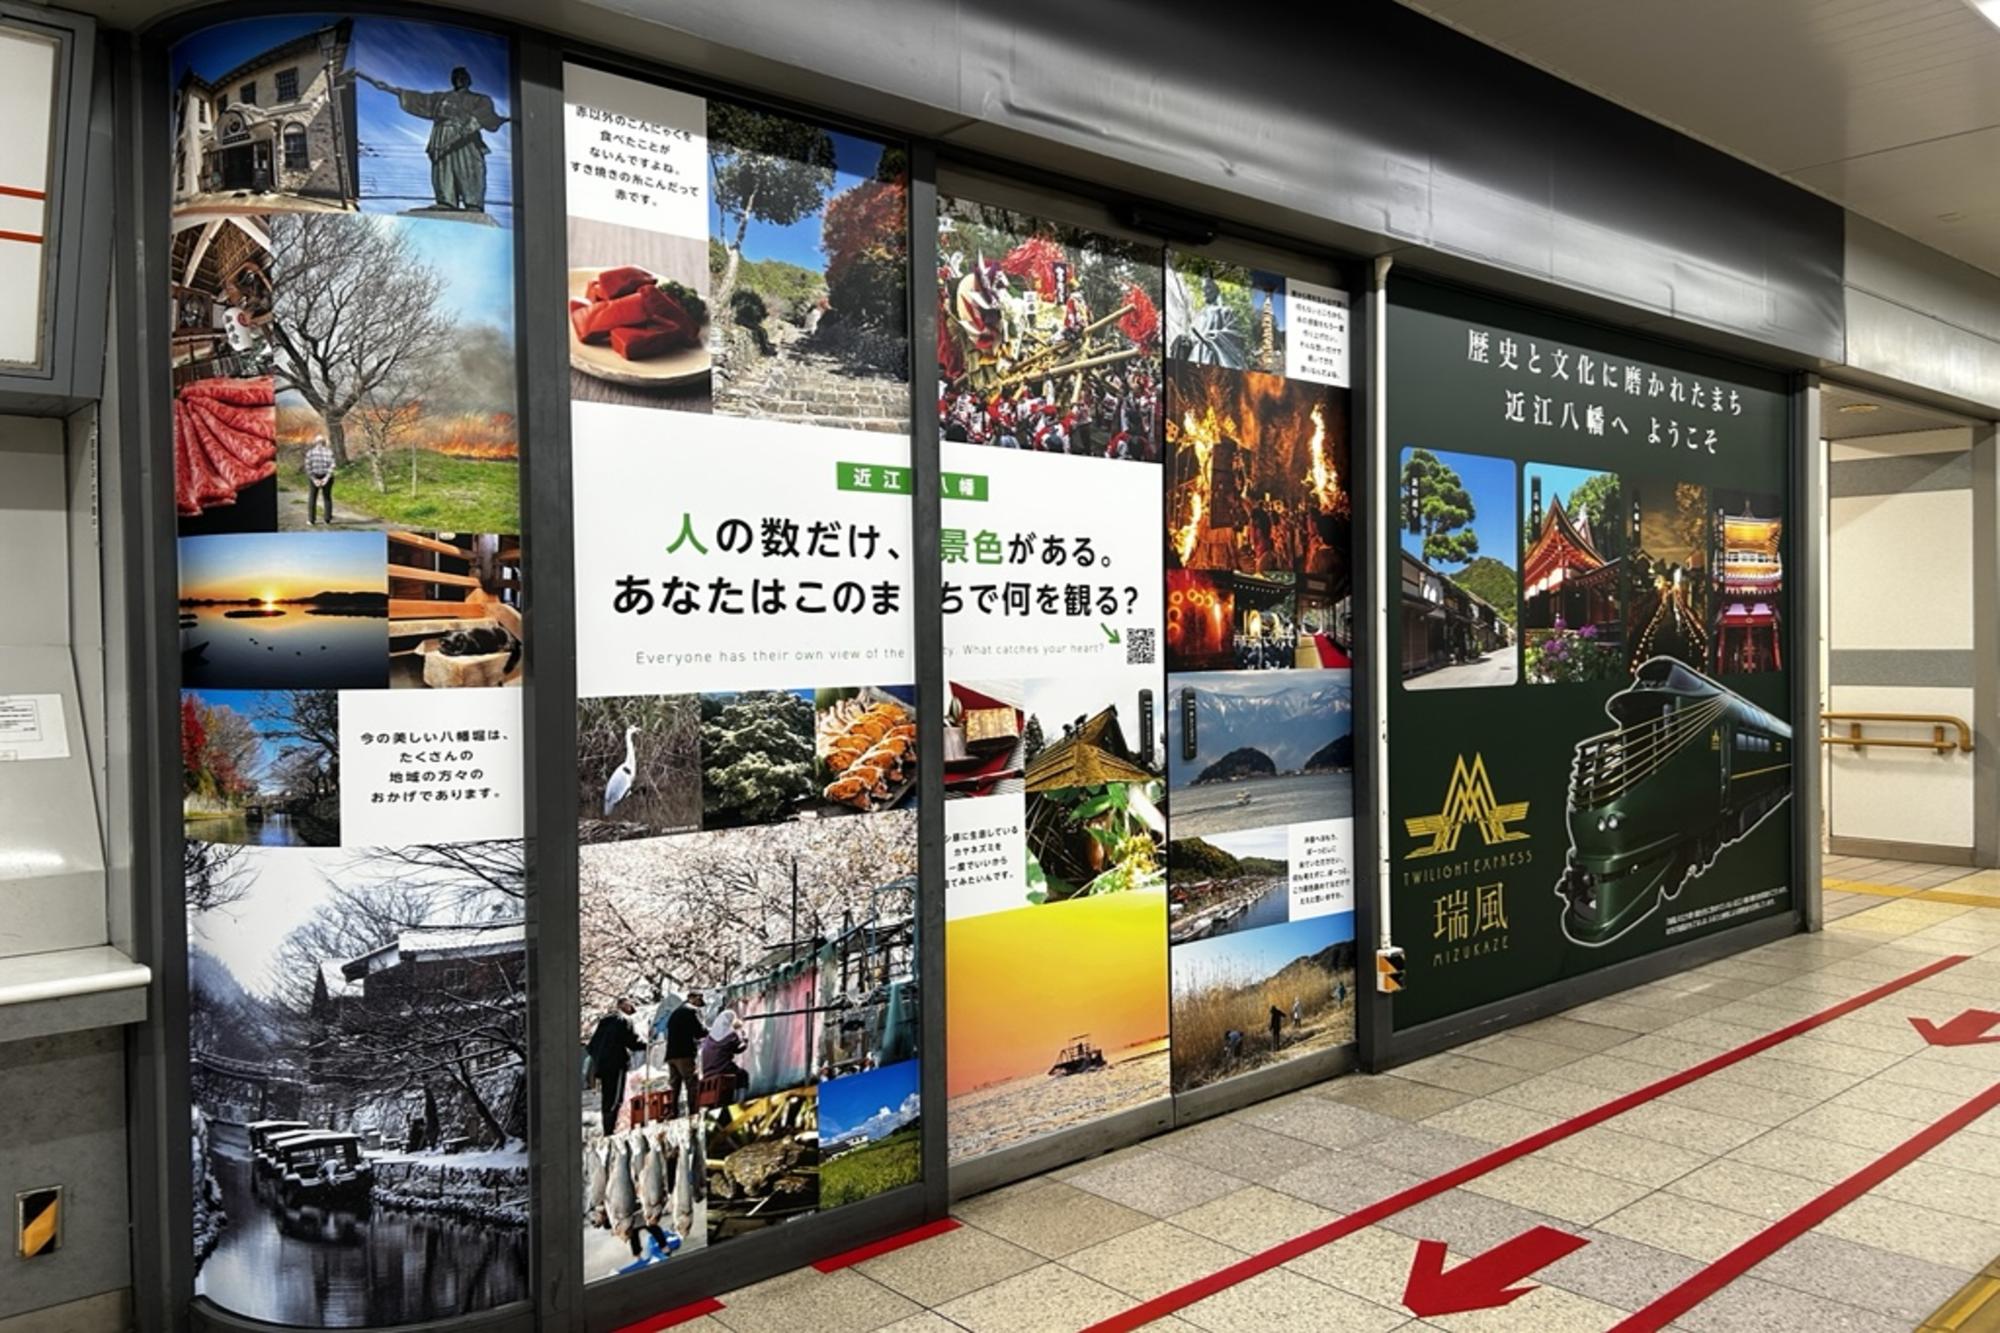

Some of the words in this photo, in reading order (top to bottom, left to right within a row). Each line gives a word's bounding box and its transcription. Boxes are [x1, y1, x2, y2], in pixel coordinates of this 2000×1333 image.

[576, 105, 693, 142] 赤以外のこんにゃくを
[600, 130, 671, 154] 食べたことが
[589, 146, 680, 175] ないんですよね。
[570, 161, 699, 197] すき焼きの糸こんだって
[615, 189, 657, 206] 赤です。
[1467, 329, 1742, 416] 歴史と文化に磨かれたまち
[1504, 390, 1629, 436] 近江八幡へ
[1647, 417, 1718, 454] ようこそ
[635, 651, 712, 666] Everyone
[719, 651, 747, 663] has
[752, 649, 790, 661] their
[796, 650, 824, 661] own
[829, 648, 861, 660] view
[866, 648, 879, 659] of
[884, 647, 906, 659] the
[962, 644, 992, 655] What
[996, 643, 1039, 654] catches
[1043, 645, 1067, 656] your
[1070, 643, 1105, 654] heart?
[360, 730, 509, 745] 今の美しい八幡堀は、
[399, 750, 474, 763] たくさんの
[389, 769, 484, 784] 地域の方々の
[370, 788, 500, 804] おかげであります。
[1403, 861, 1469, 887] TWILIGHT
[1473, 850, 1533, 874] EXPRESS
[1432, 881, 1509, 943] 瑞風
[1432, 935, 1510, 968] MIZUKAZE
